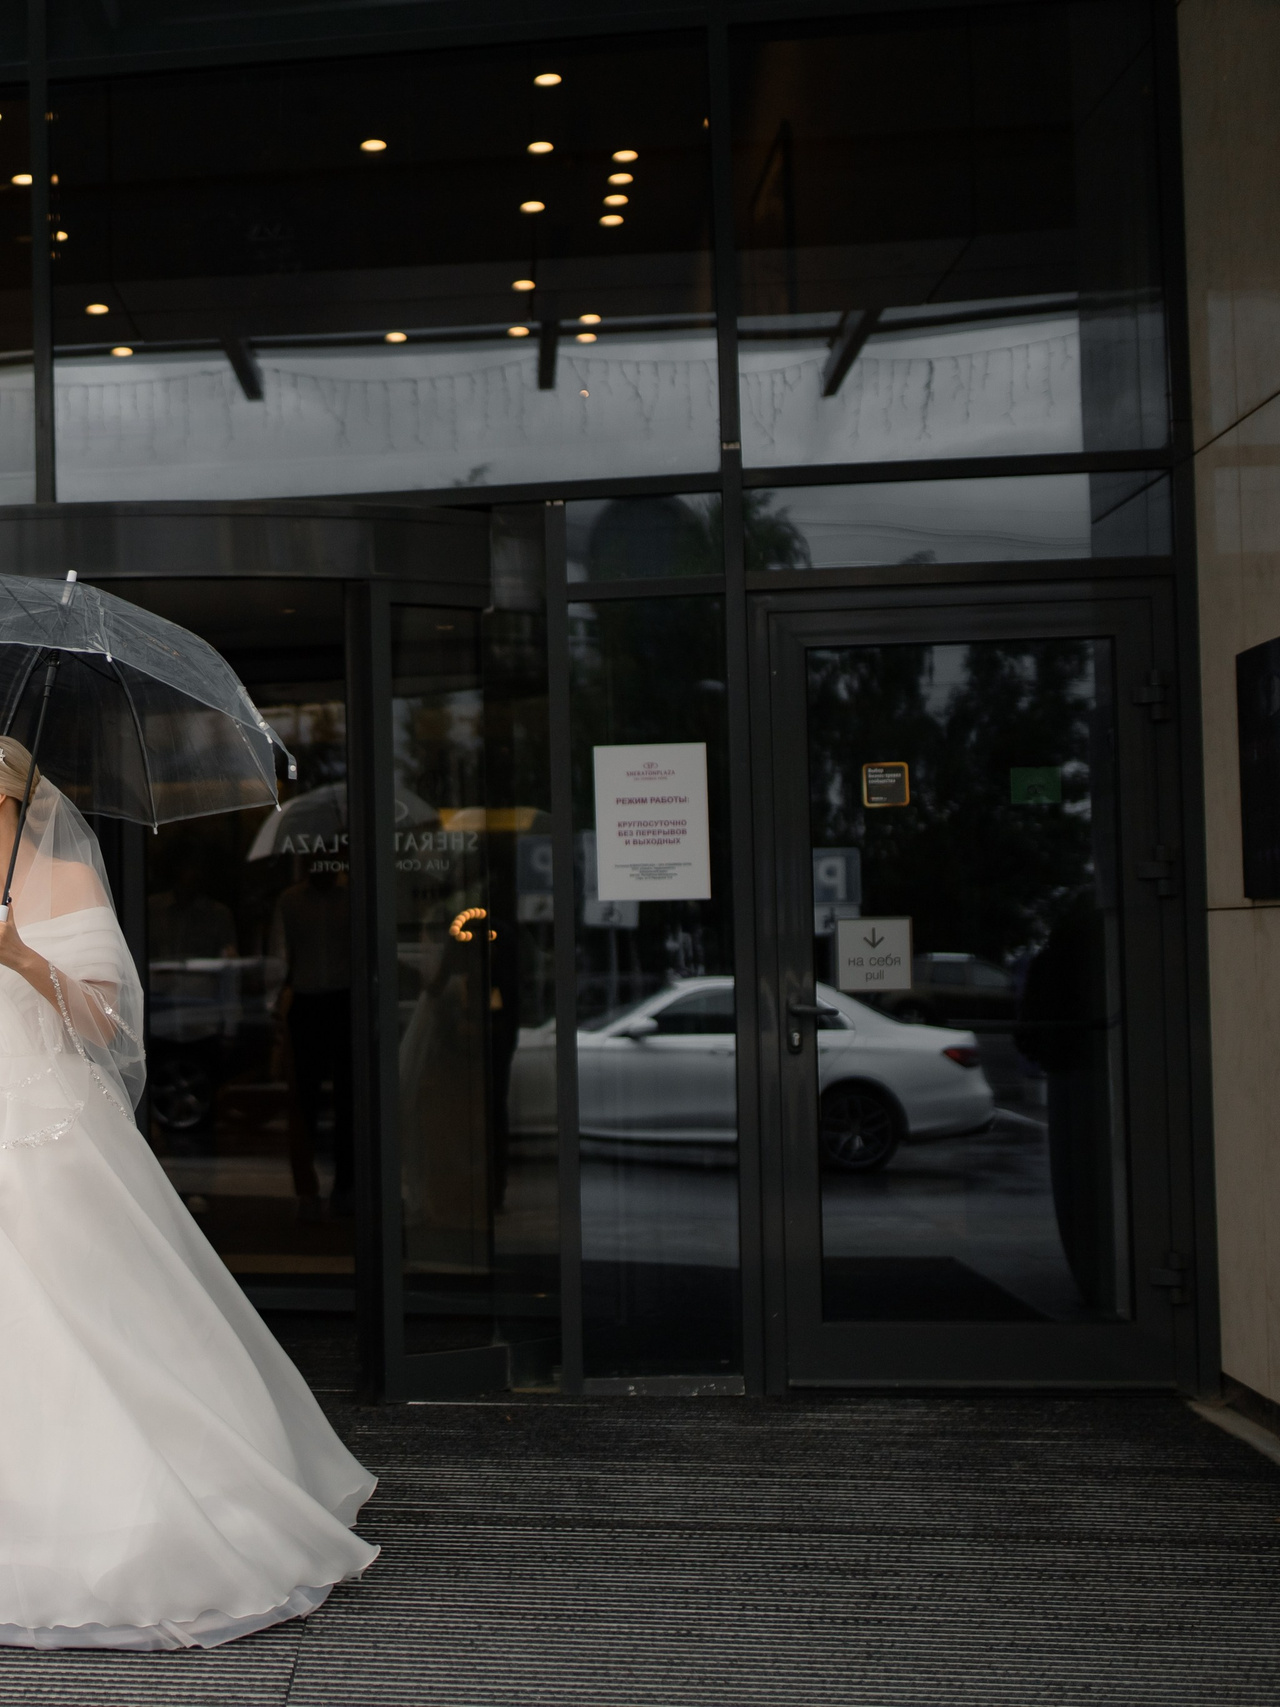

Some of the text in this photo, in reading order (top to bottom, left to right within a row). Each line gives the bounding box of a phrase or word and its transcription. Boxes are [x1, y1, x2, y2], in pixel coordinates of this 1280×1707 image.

[626, 769, 676, 777] SHERATONPLAZA
[616, 796, 690, 805] РЕЖИМ РАБОТЫ:
[617, 819, 687, 828] КРУГЛОСУТОЧНО
[618, 828, 687, 837] БЕЗ ПЕРЕРЫВОВ
[632, 838, 681, 846] ВЫХОДНЫХ
[848, 953, 901, 967] на себя
[865, 970, 885, 982] pull
